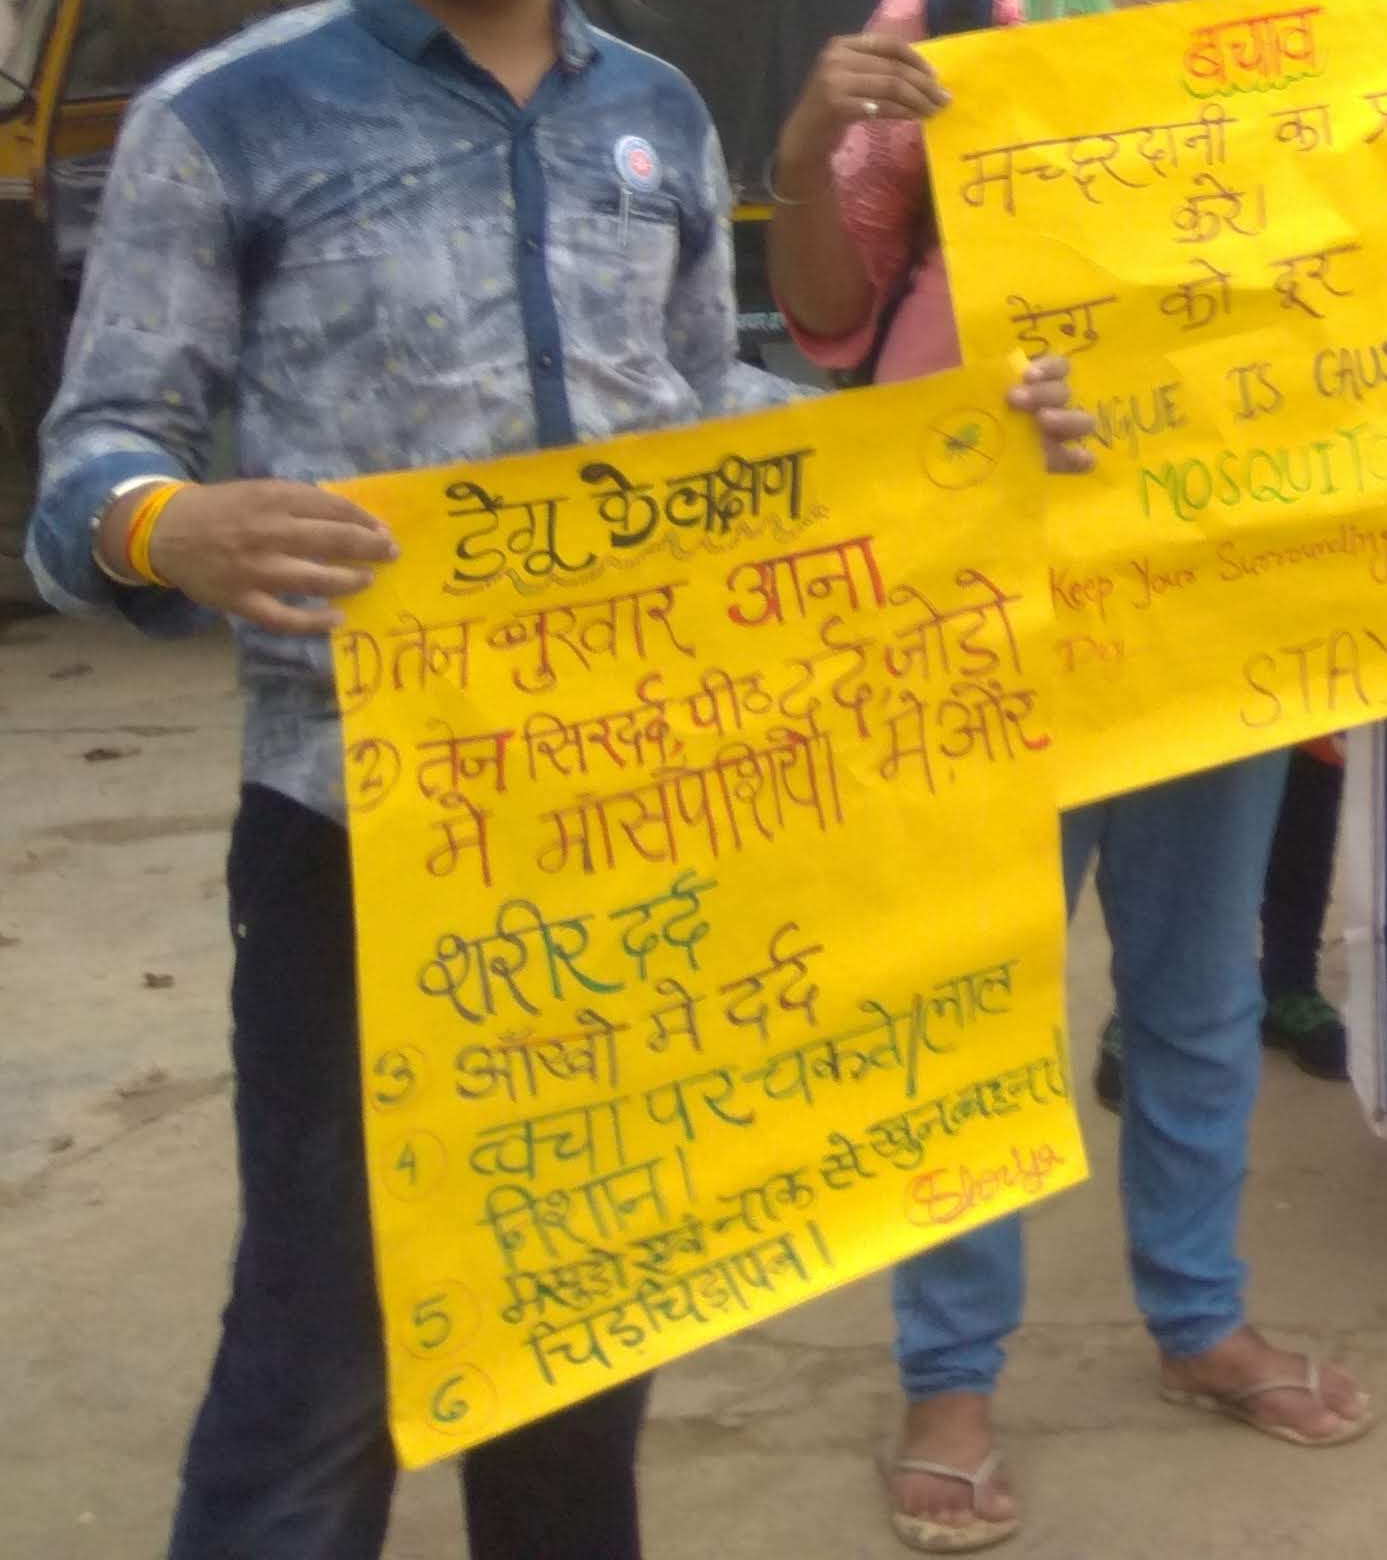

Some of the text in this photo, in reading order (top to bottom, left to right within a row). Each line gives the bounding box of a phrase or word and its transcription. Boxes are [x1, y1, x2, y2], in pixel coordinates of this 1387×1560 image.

[1184, 5, 1325, 83] बचाव
[1271, 104, 1332, 152] का
[1159, 257, 1231, 332] को
[1268, 243, 1360, 320] दूर
[1092, 380, 1188, 460] NGUE
[1227, 360, 1283, 421] IS
[580, 462, 659, 548] के
[665, 448, 816, 535] लक्षण
[727, 535, 888, 628] आना
[1048, 567, 1114, 623] Keep
[416, 718, 516, 798] तेज
[686, 667, 773, 737] पीठ
[418, 870, 719, 1025] शरीर दर्द
[719, 921, 825, 1032] दर्द
[468, 1095, 631, 1180] त्वचा
[645, 1065, 756, 1141] पर
[711, 1168, 816, 1233] नाक
[819, 1131, 876, 1191] से
